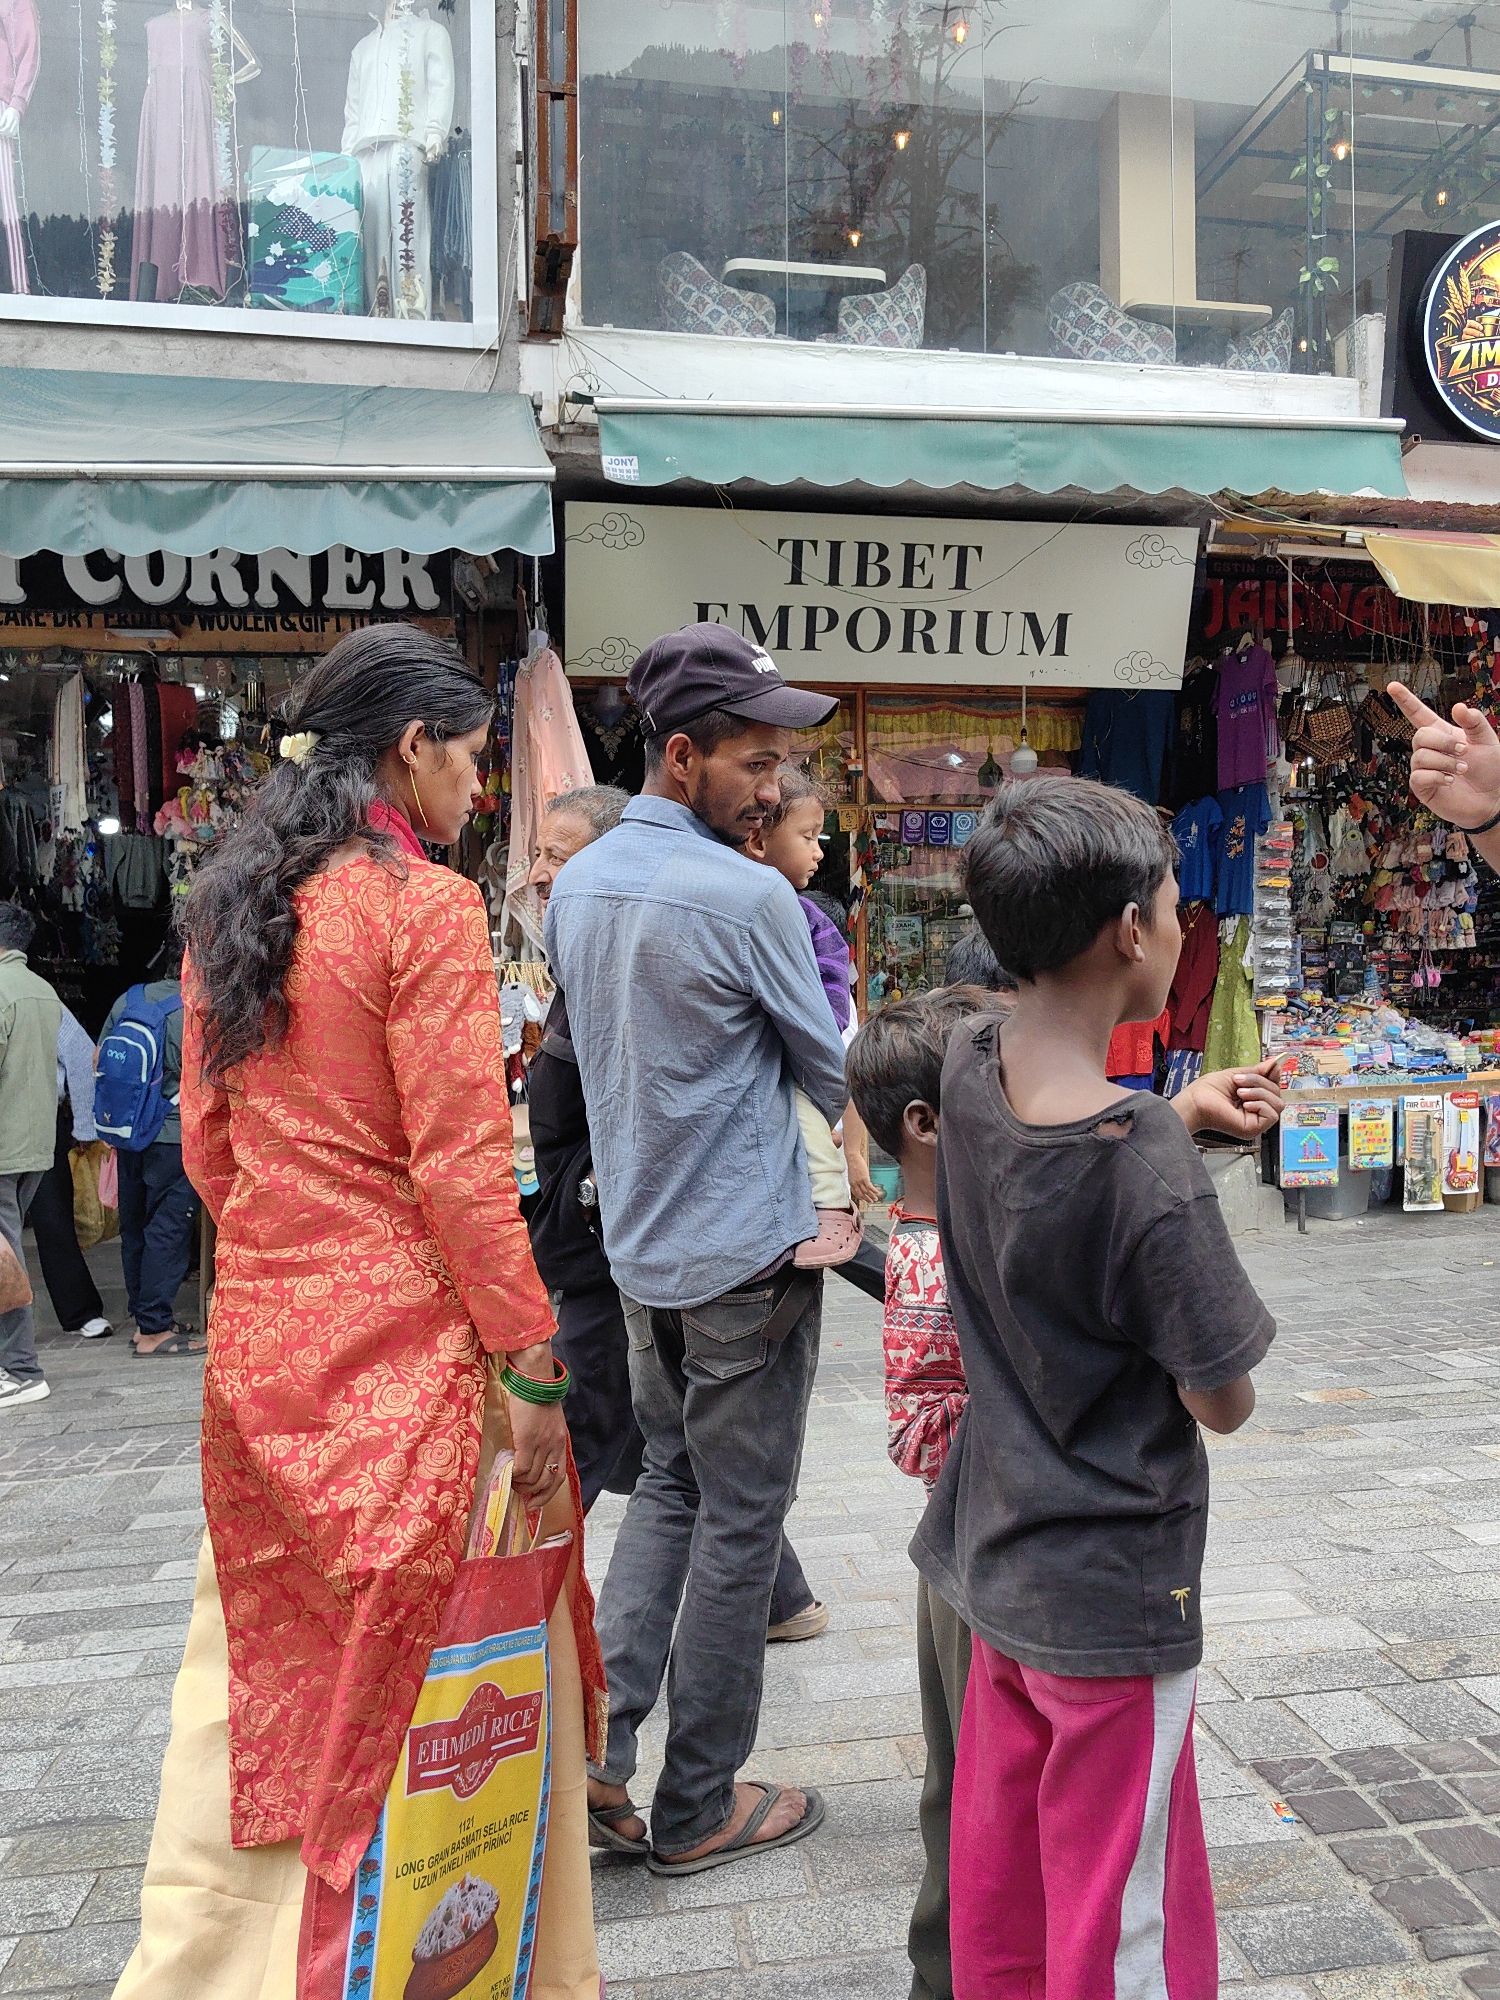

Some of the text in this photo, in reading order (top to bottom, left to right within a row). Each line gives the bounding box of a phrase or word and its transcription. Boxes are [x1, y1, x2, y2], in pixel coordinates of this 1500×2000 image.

[607, 457, 635, 467] JONY
[62, 544, 441, 609] CORNER
[776, 538, 984, 592] TIBET
[52, 611, 94, 629] DRY
[199, 613, 278, 633] WOOLEN
[279, 613, 297, 632] &
[299, 613, 343, 633] GIFT
[1406, 1100, 1439, 1109] AIR GUN
[489, 1707, 535, 1739] RICE
[458, 1815, 475, 1834] 1121
[395, 1809, 530, 1879] LONG GRAIN BASMATI SELLA RICE
[413, 1870, 438, 1891] UZUN
[464, 1843, 482, 1863] HINT
[490, 1980, 502, 1993] NET
